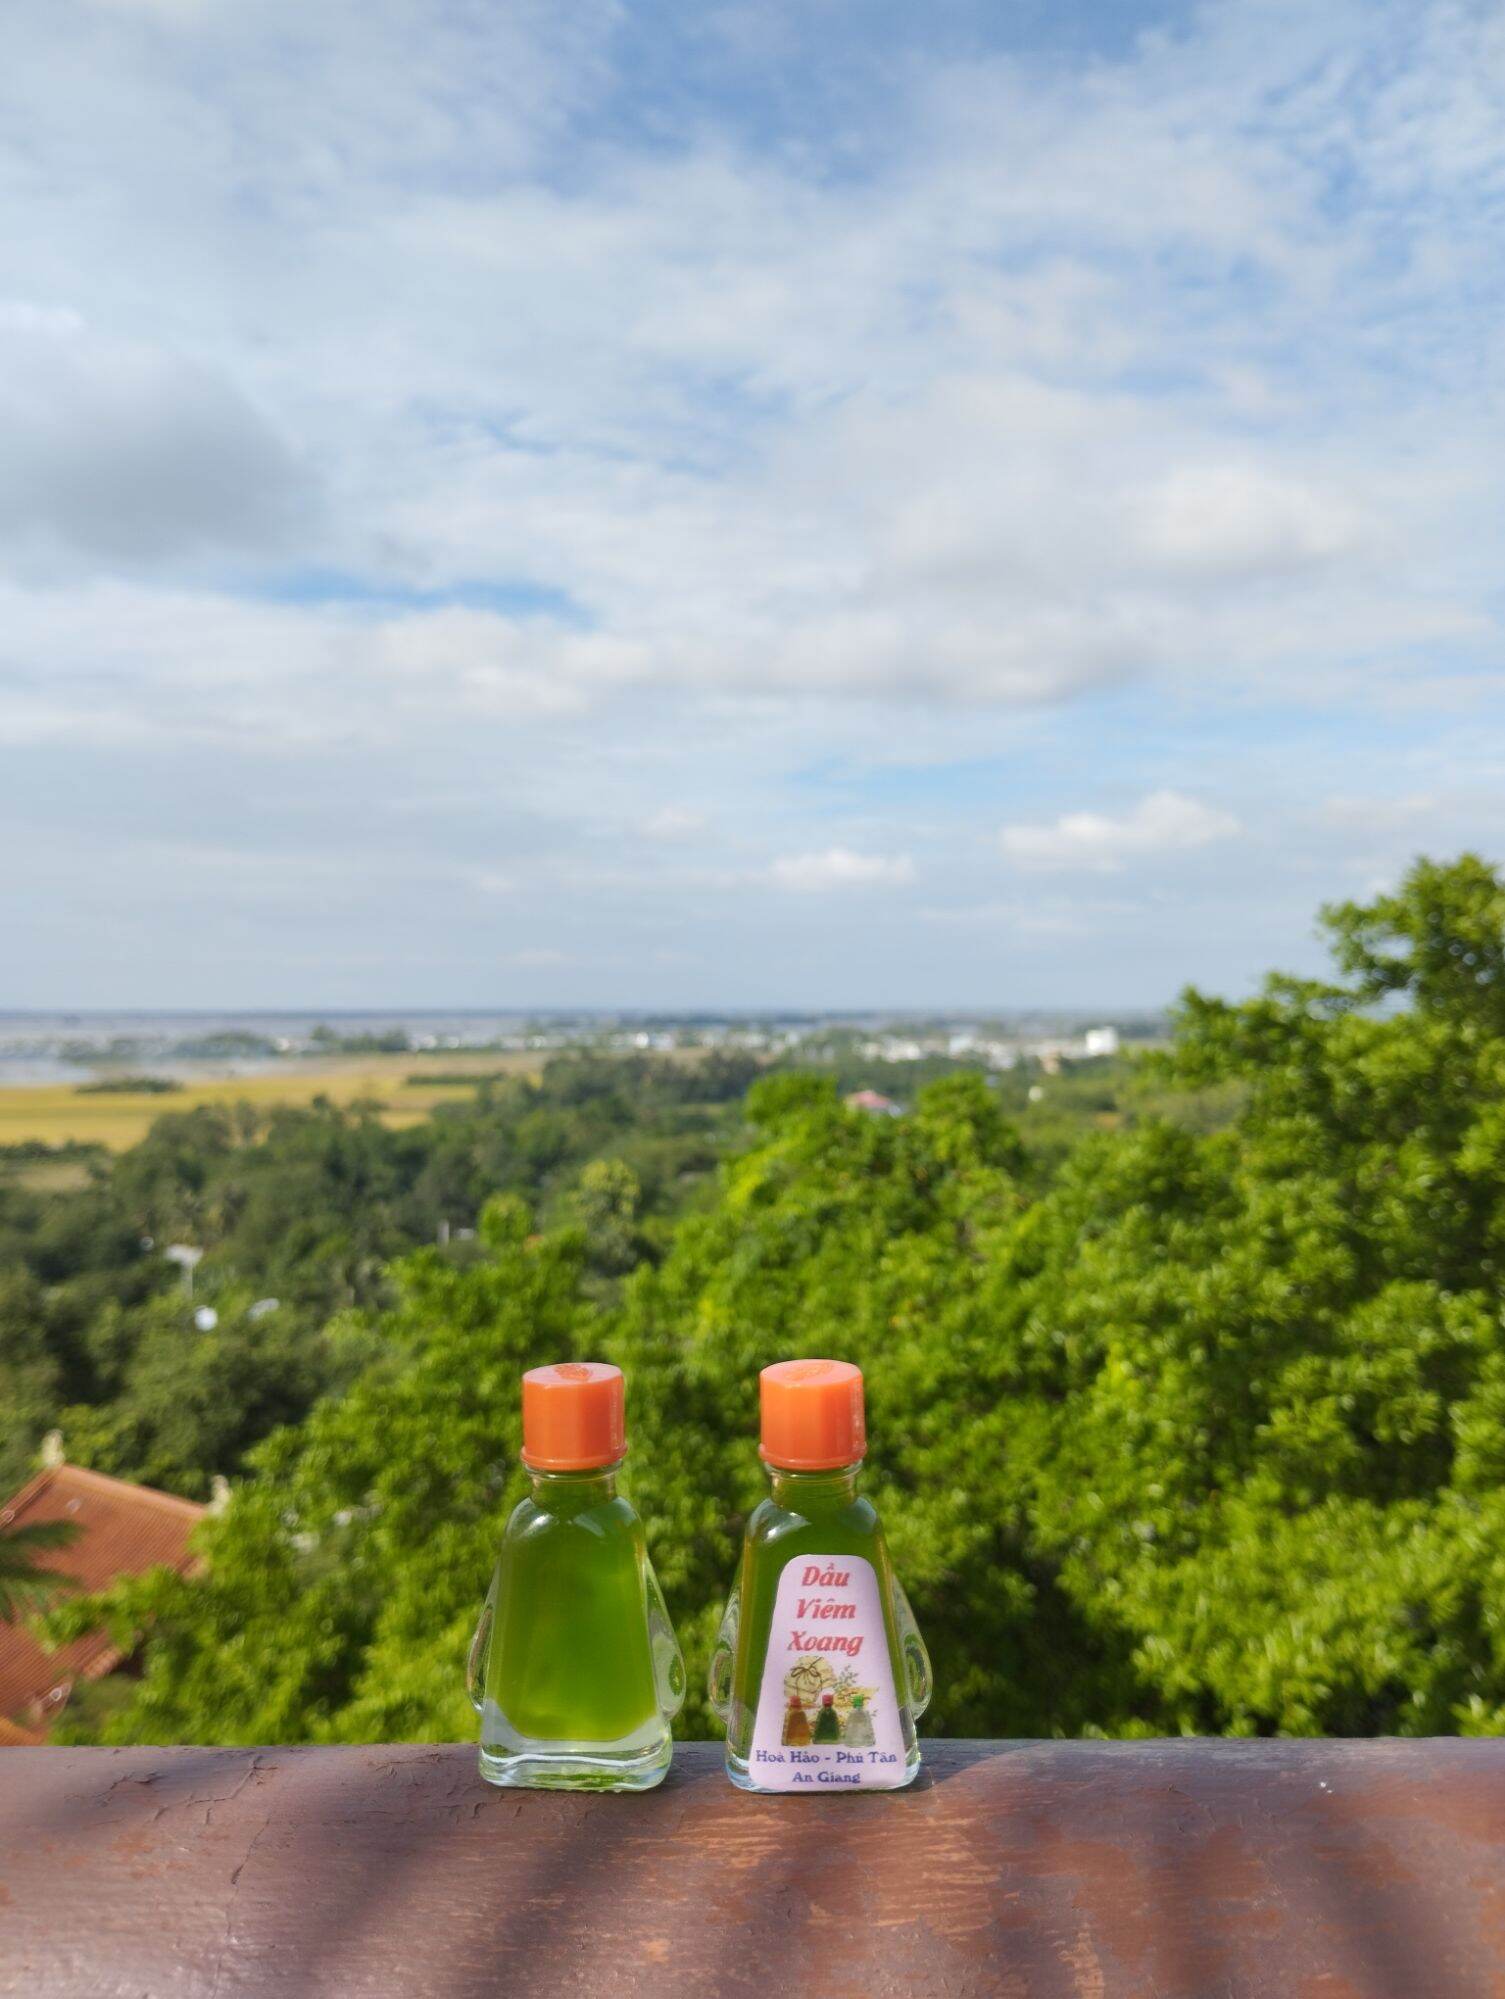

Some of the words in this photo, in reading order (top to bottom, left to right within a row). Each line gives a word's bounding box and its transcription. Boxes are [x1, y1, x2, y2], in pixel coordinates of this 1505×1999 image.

[795, 1598, 857, 1619] Viêm
[787, 1630, 865, 1657] Xoang
[868, 1751, 897, 1763] Tân
[792, 1772, 813, 1783] An
[818, 1771, 861, 1784] Giang
